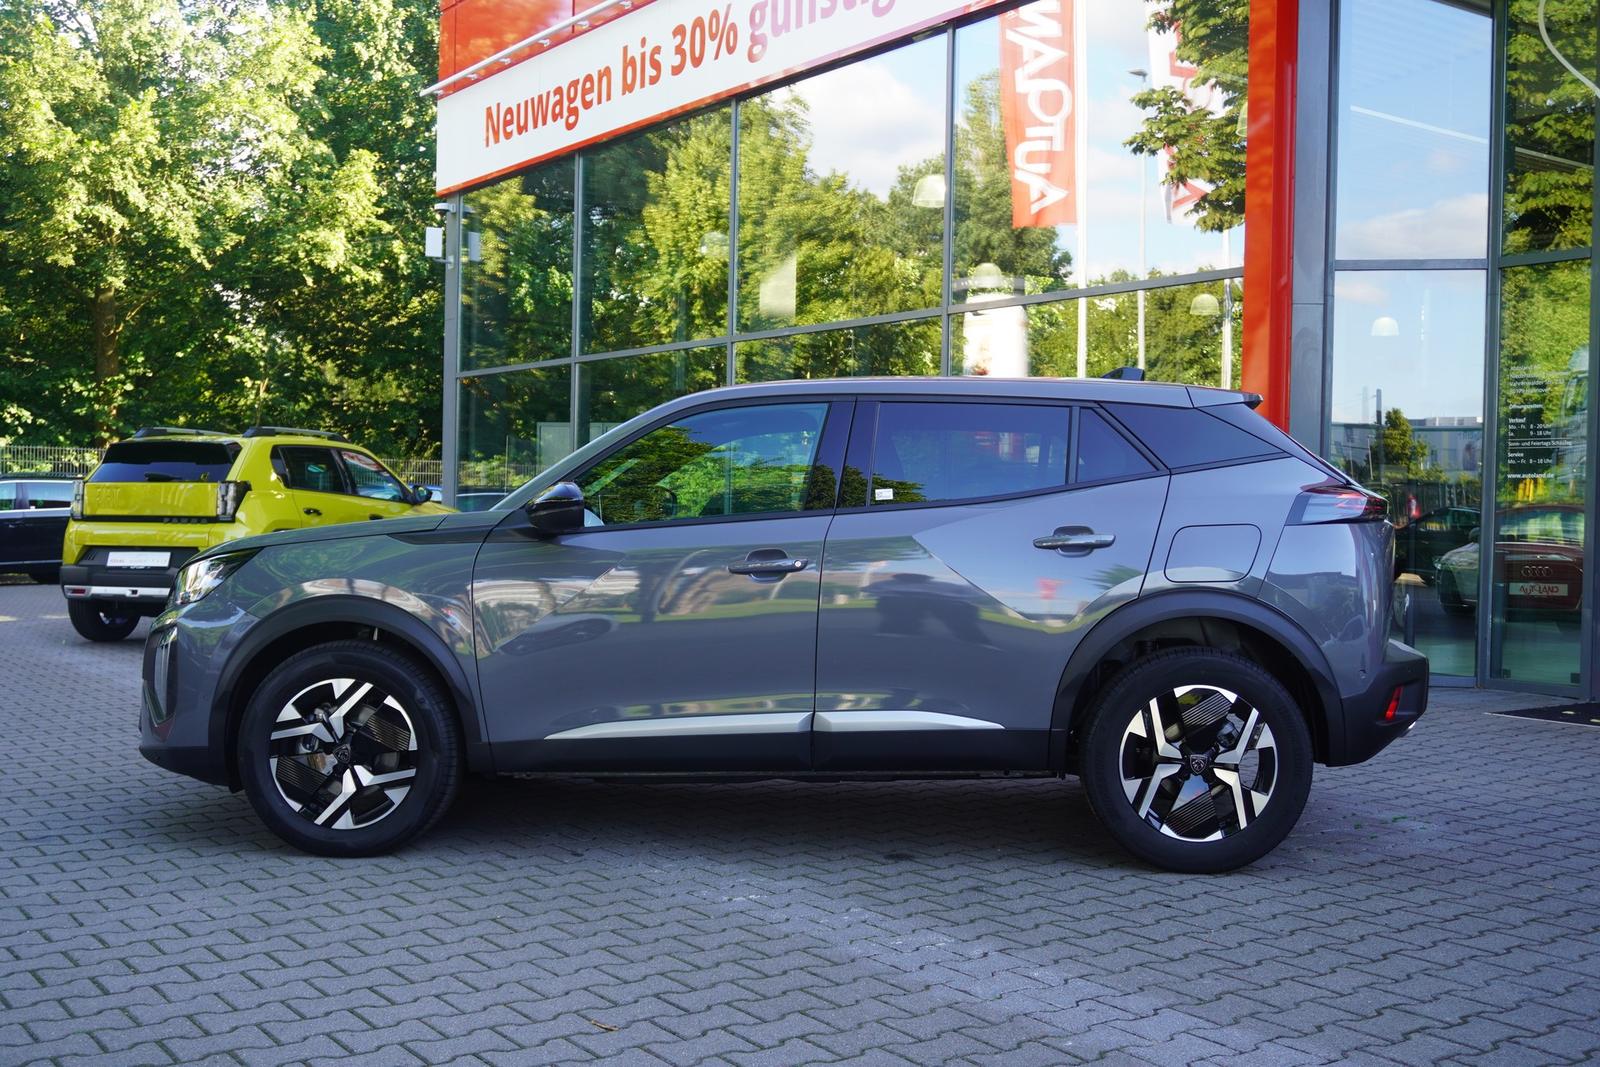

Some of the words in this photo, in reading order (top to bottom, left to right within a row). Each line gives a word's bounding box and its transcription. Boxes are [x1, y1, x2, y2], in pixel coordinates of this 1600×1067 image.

[485, 65, 612, 148] Neuwagen
[621, 37, 662, 96] bis
[671, 3, 738, 76] 30%
